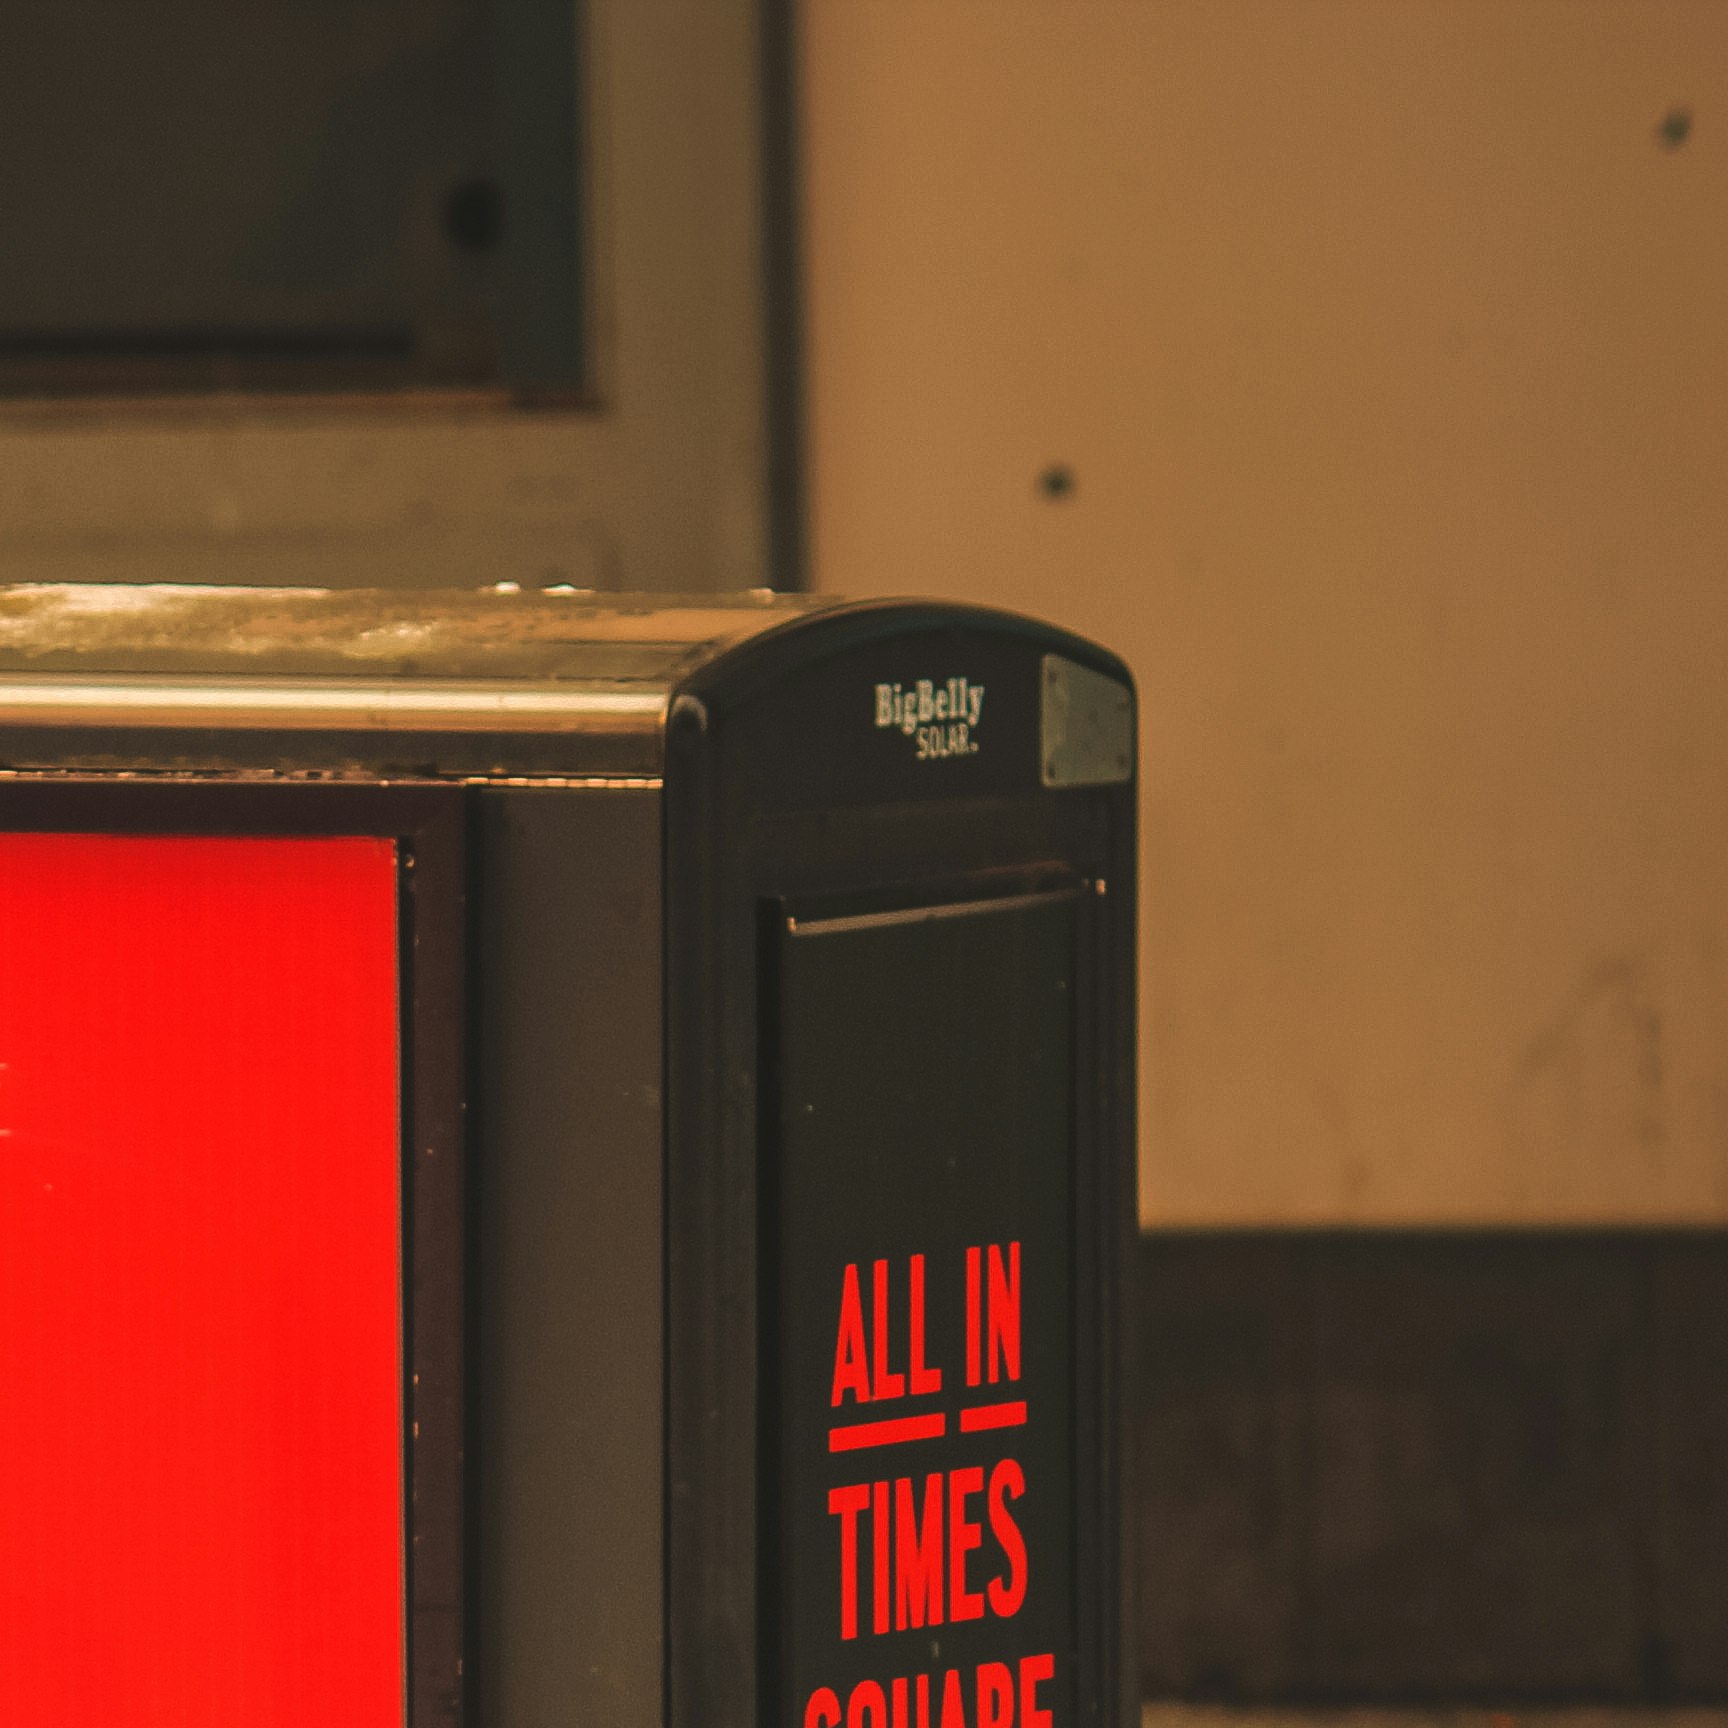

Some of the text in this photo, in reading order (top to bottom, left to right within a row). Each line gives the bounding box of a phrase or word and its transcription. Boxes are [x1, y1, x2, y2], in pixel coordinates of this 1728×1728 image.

[875, 677, 984, 735] BigBelly
[831, 1241, 1021, 1407] ALL IN
[828, 1458, 1028, 1640] TIMES
